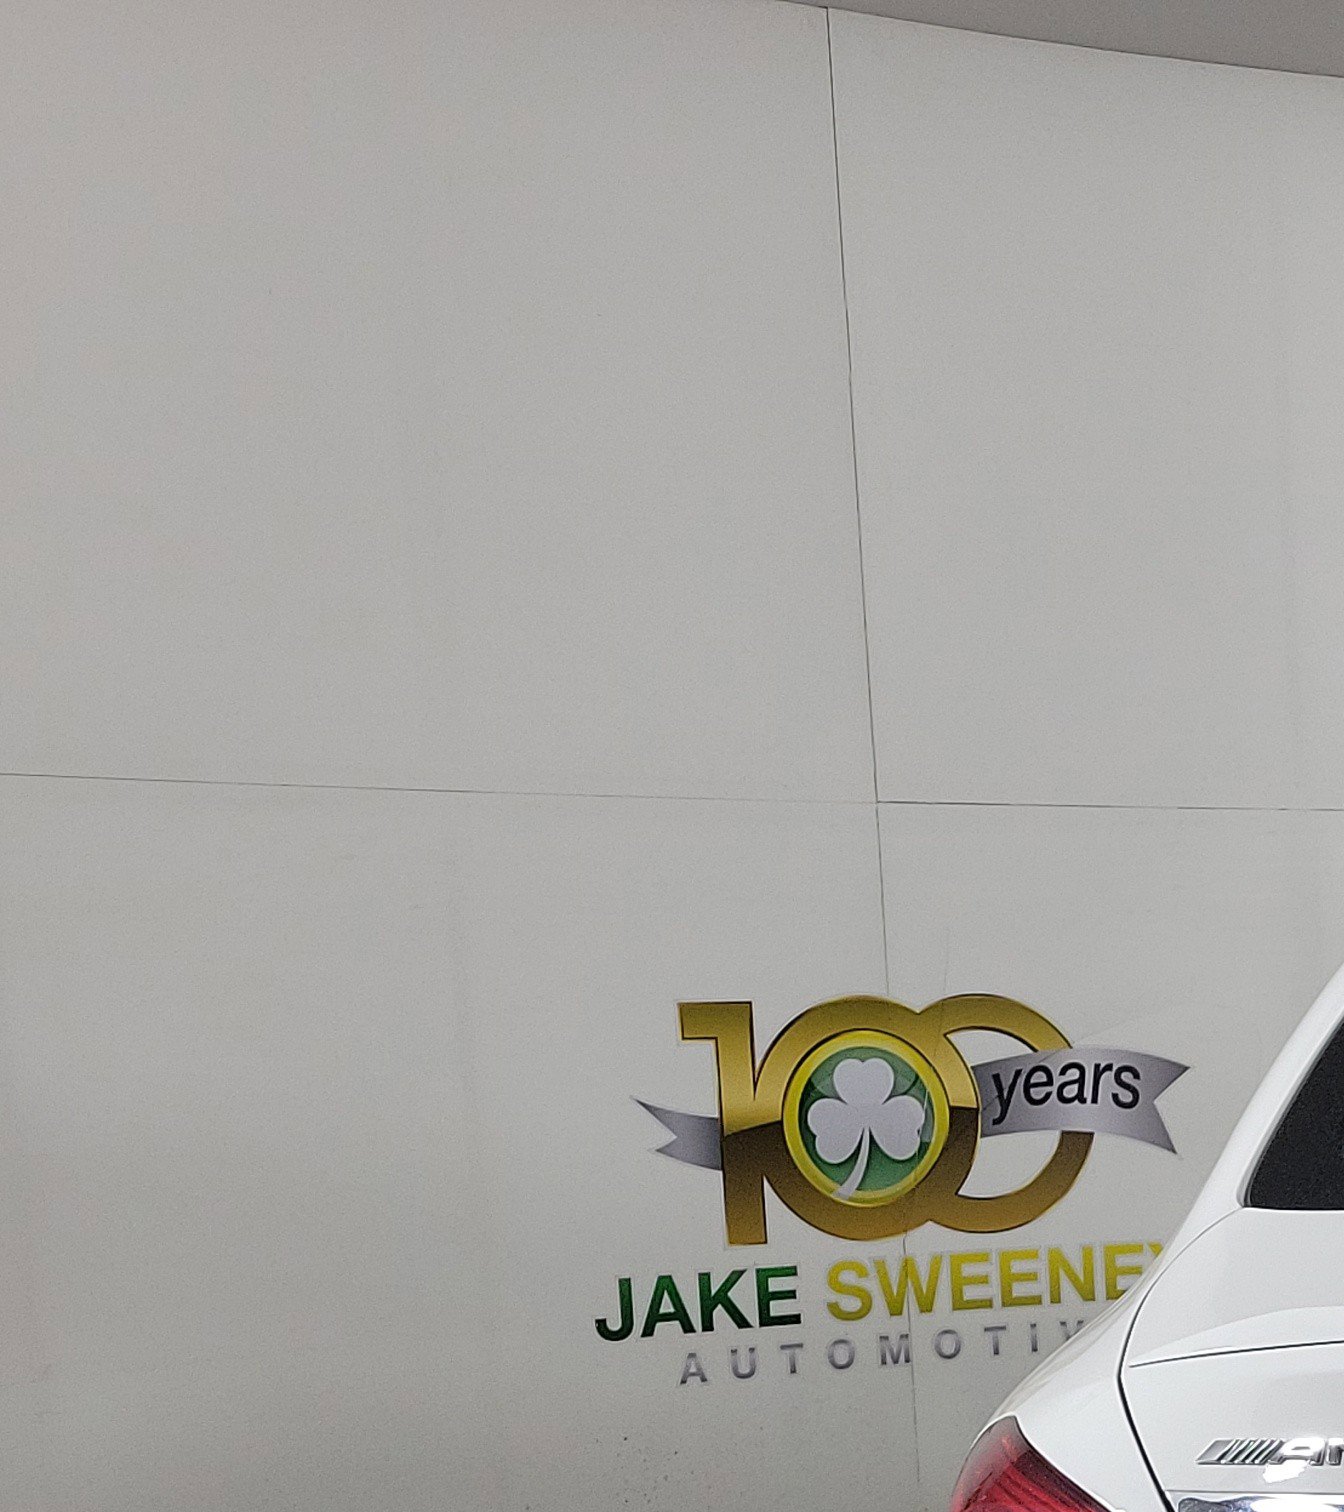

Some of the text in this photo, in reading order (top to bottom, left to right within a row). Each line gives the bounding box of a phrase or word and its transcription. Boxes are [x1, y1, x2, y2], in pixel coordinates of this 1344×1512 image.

[676, 992, 1142, 1246] 100 years
[594, 1242, 1165, 1342] JAKE SWEENE
[678, 1319, 1085, 1387] AUTOMOTIV
